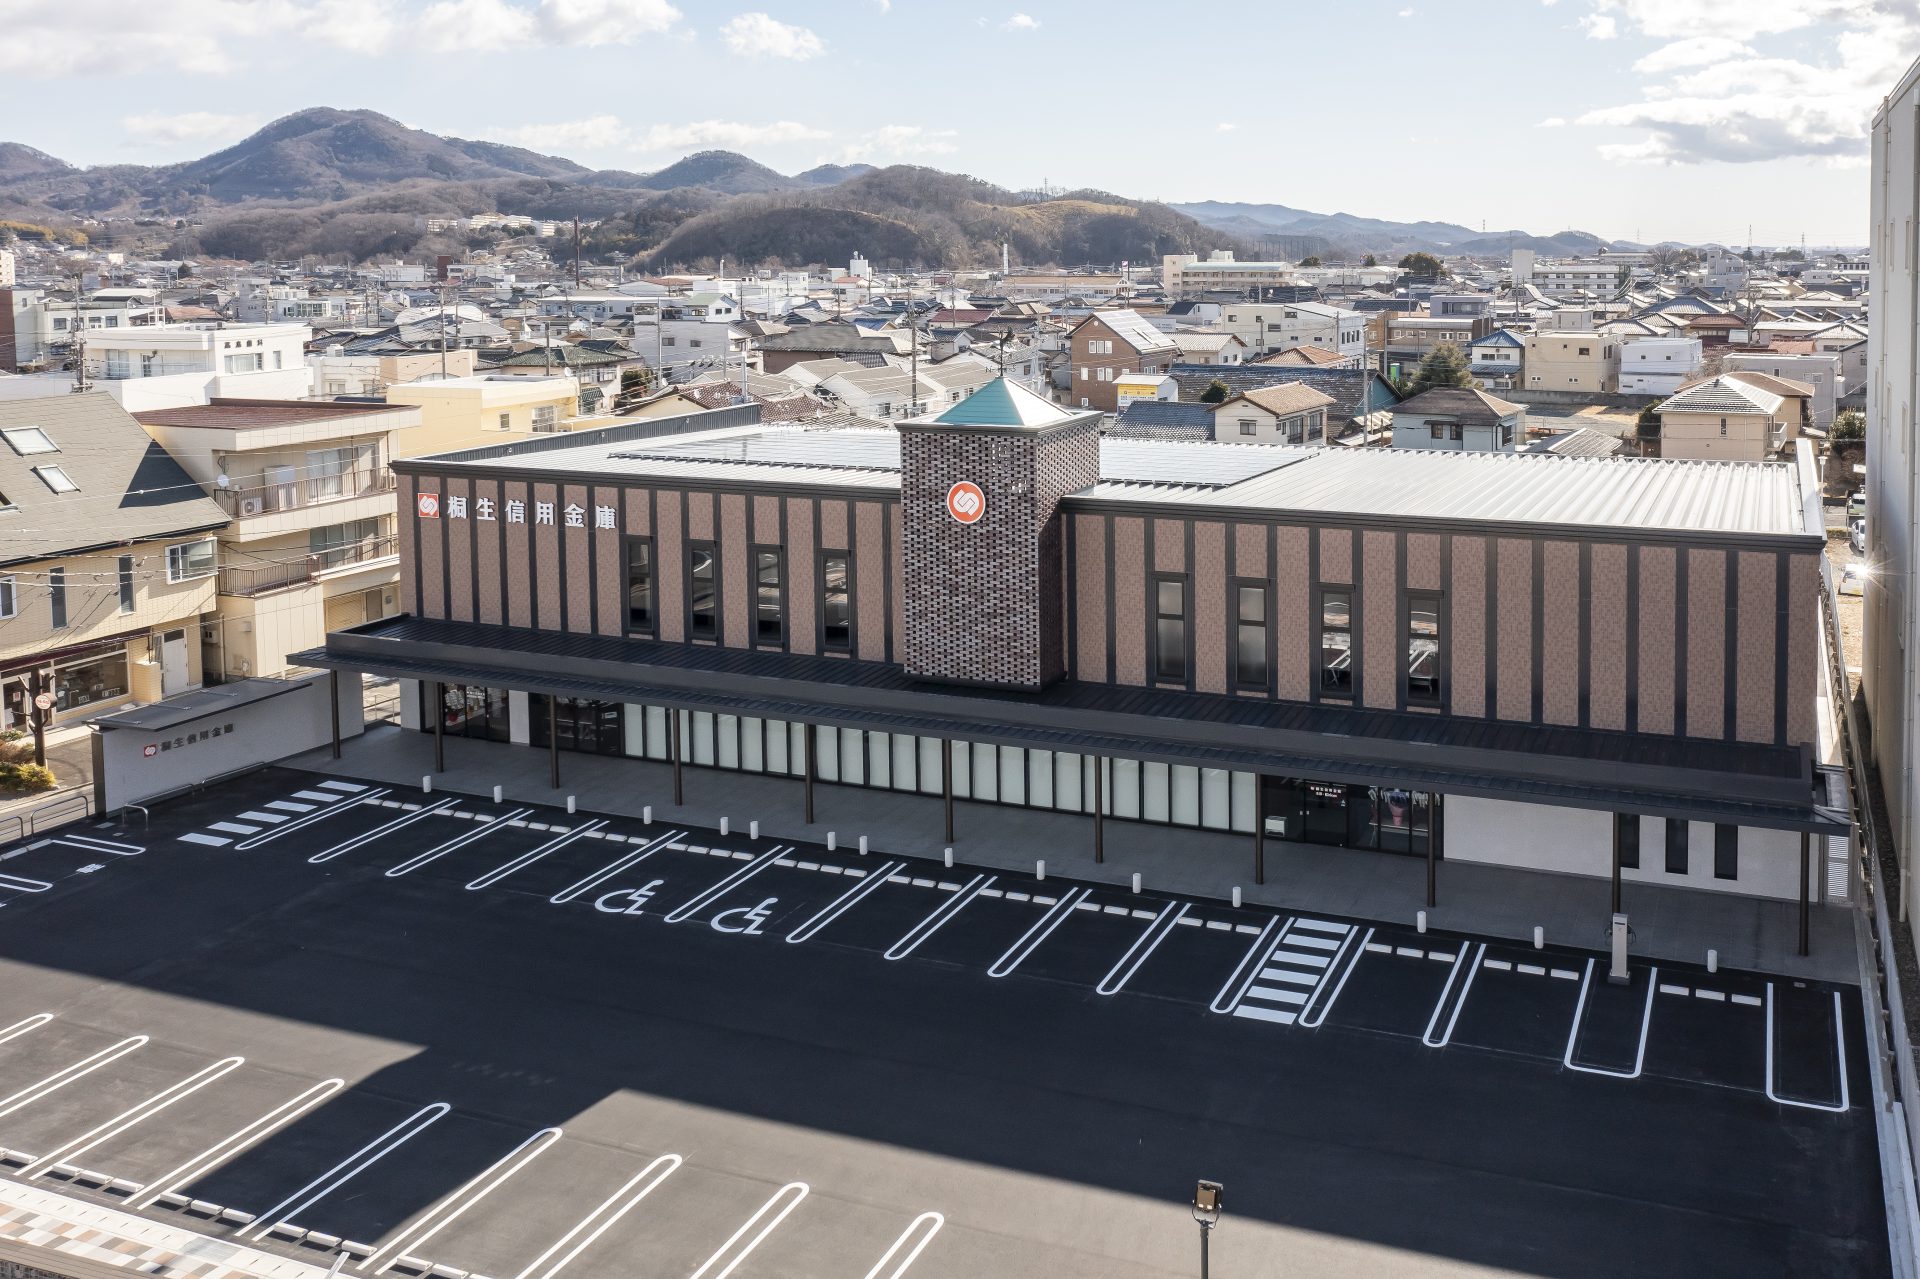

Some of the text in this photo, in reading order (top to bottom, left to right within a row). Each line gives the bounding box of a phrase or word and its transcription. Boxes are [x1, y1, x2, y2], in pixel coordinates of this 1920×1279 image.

[447, 496, 616, 530] 桐生信用金庫
